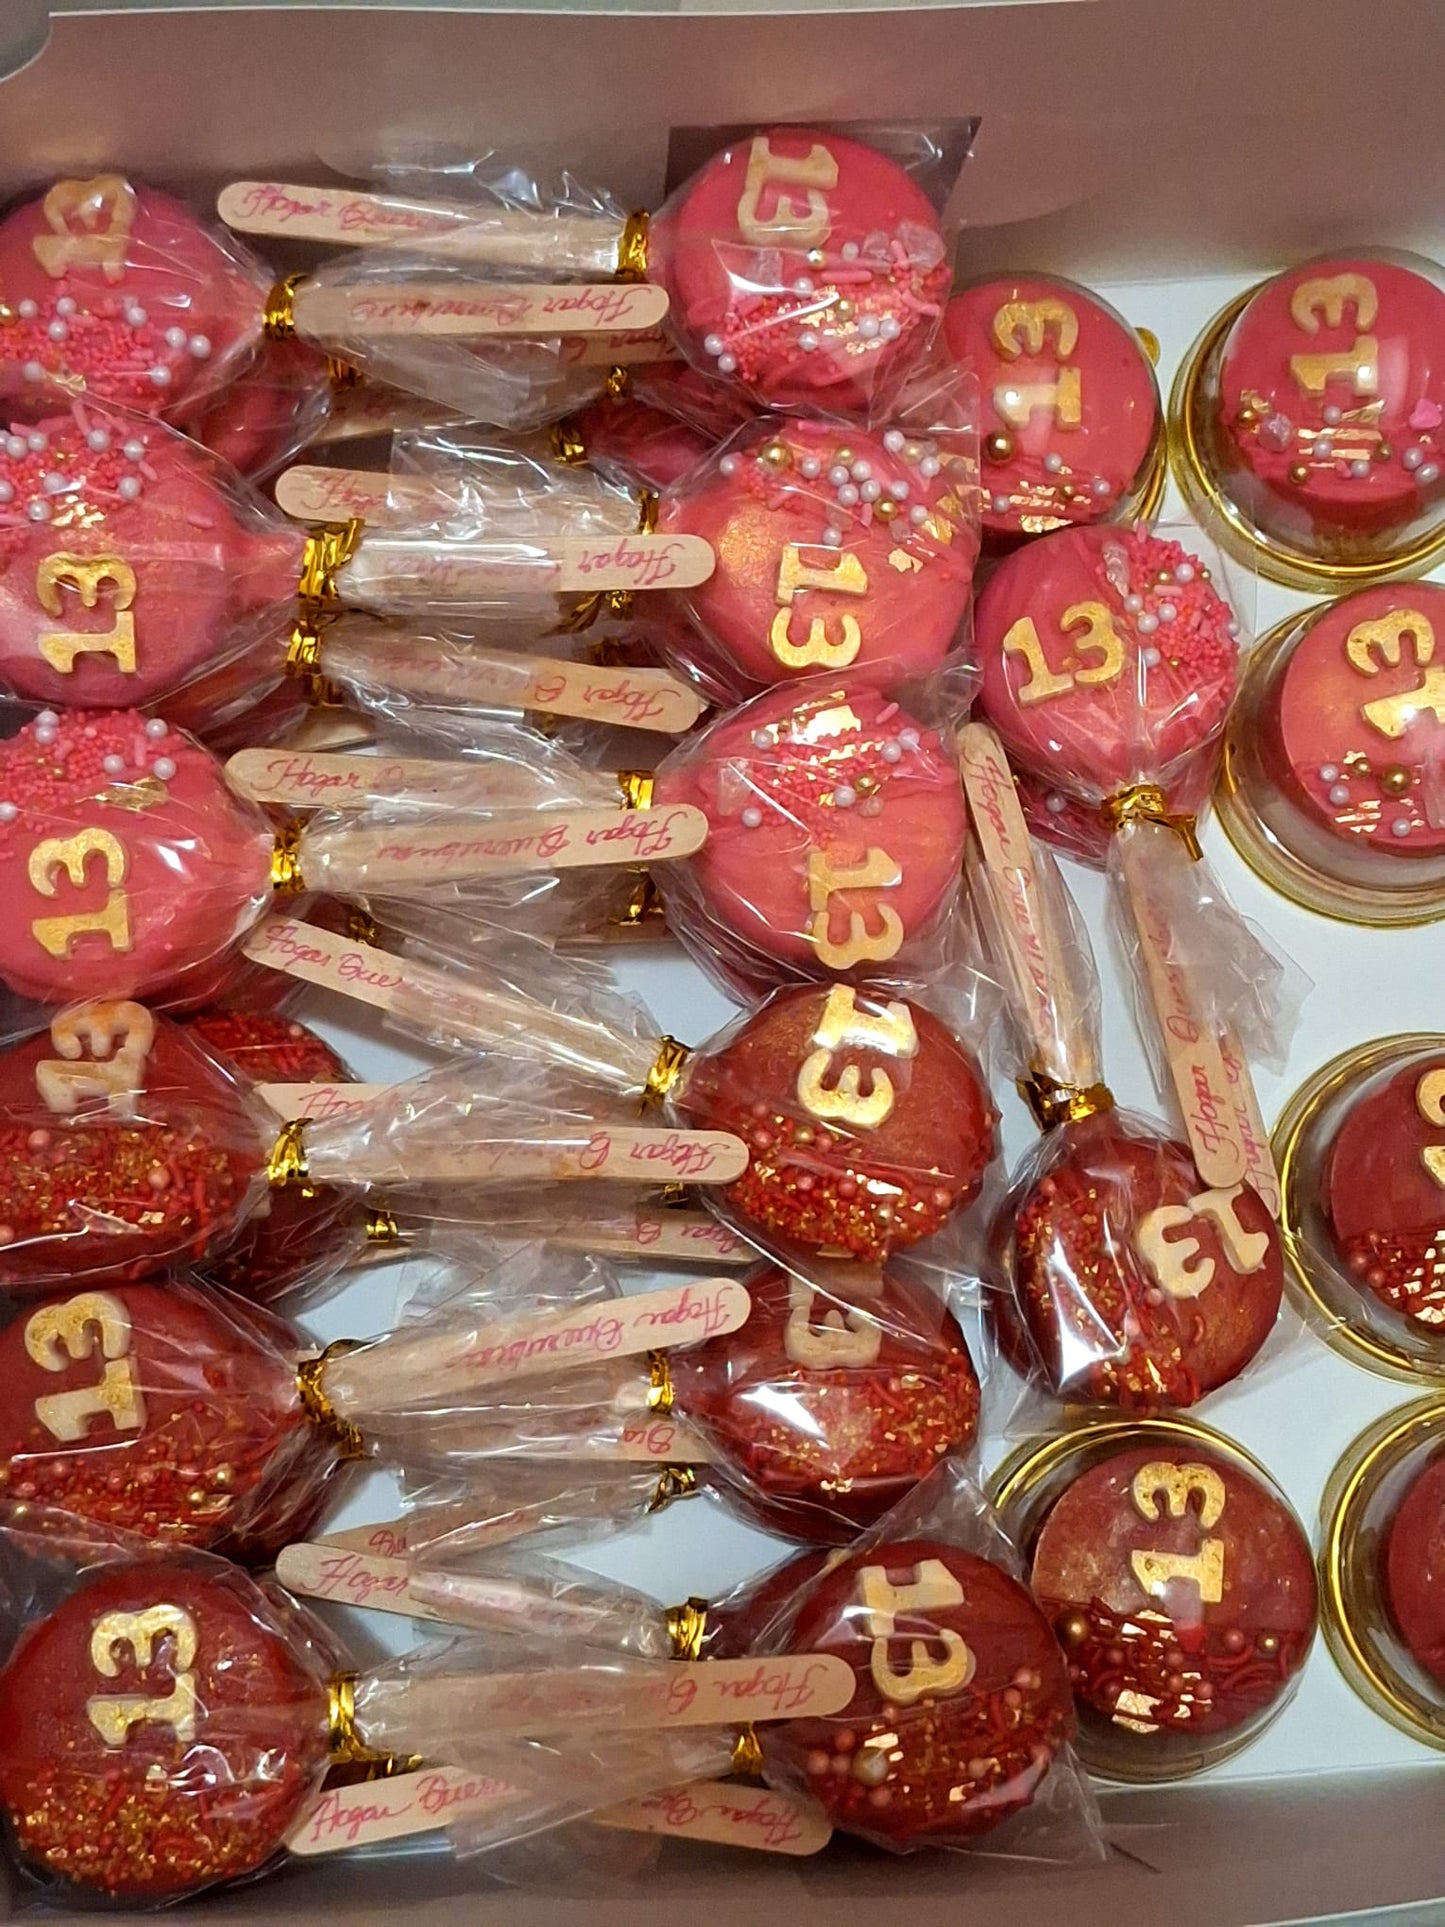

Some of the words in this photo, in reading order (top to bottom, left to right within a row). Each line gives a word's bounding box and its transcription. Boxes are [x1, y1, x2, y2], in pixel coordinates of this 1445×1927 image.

[737, 136, 839, 246] 13
[543, 286, 652, 327] Hogar
[1290, 272, 1380, 397] 13
[992, 300, 1080, 430] 13
[36, 551, 137, 674] 13
[769, 544, 868, 670] 13
[1002, 600, 1127, 704] 13
[583, 674, 682, 719] Hogar
[1346, 608, 1445, 741] 13
[250, 758, 362, 794] Hogar
[585, 808, 688, 858] Hogar
[963, 752, 1010, 858] Hogar
[28, 827, 130, 960] 13
[806, 845, 905, 971] 13
[35, 1000, 157, 1116] 13
[797, 983, 919, 1129] 13
[630, 1132, 733, 1175] Hogar
[1191, 1064, 1241, 1165] Hogar
[1135, 1184, 1271, 1300] 13
[24, 1291, 143, 1442] 13
[634, 1285, 735, 1338] Hogar
[1131, 1461, 1226, 1604] 13
[86, 1603, 197, 1746] 13
[714, 1663, 828, 1711] Hogar
[856, 1558, 977, 1702] 13
[309, 1796, 413, 1843] Hogar
[703, 1797, 804, 1846] Hogar
